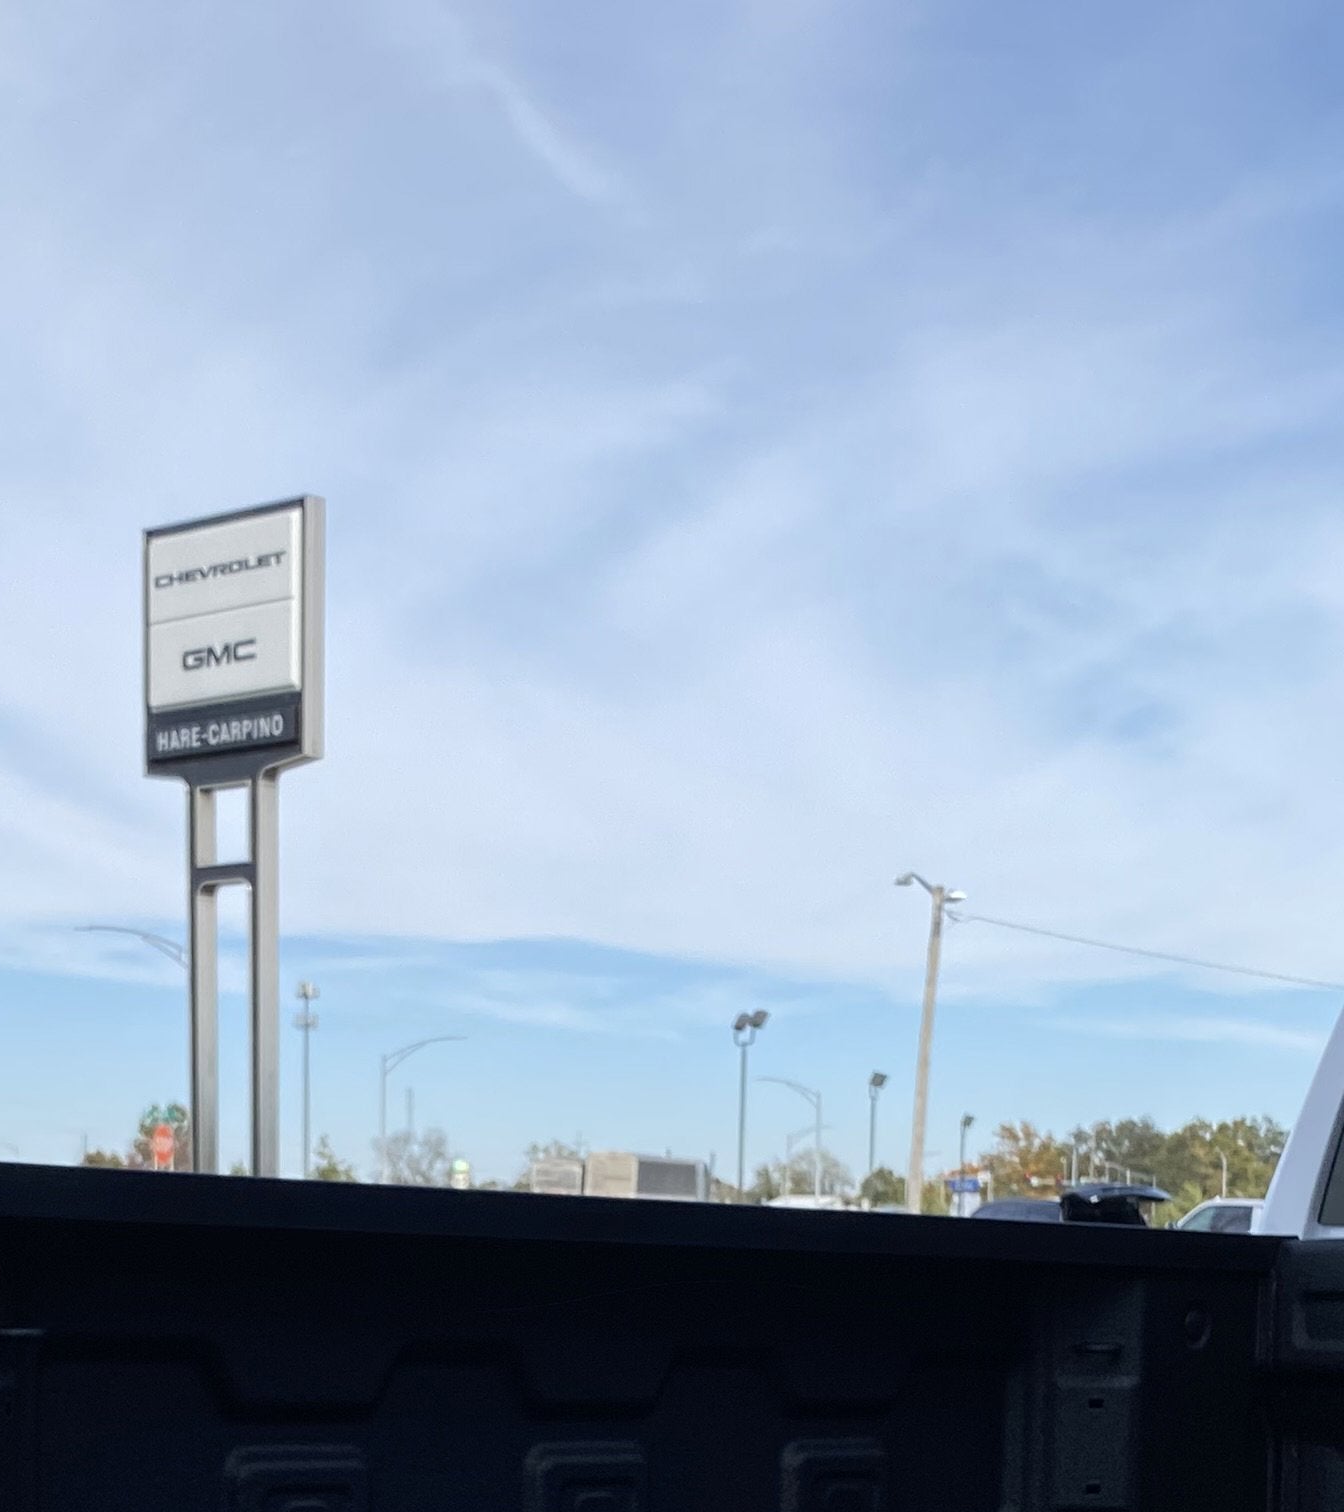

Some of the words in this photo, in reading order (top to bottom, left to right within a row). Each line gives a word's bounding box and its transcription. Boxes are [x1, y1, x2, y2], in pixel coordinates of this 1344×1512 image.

[154, 551, 288, 588] CHEVROLET
[182, 638, 258, 672] GMC
[157, 714, 284, 752] HARE-CARPINO
